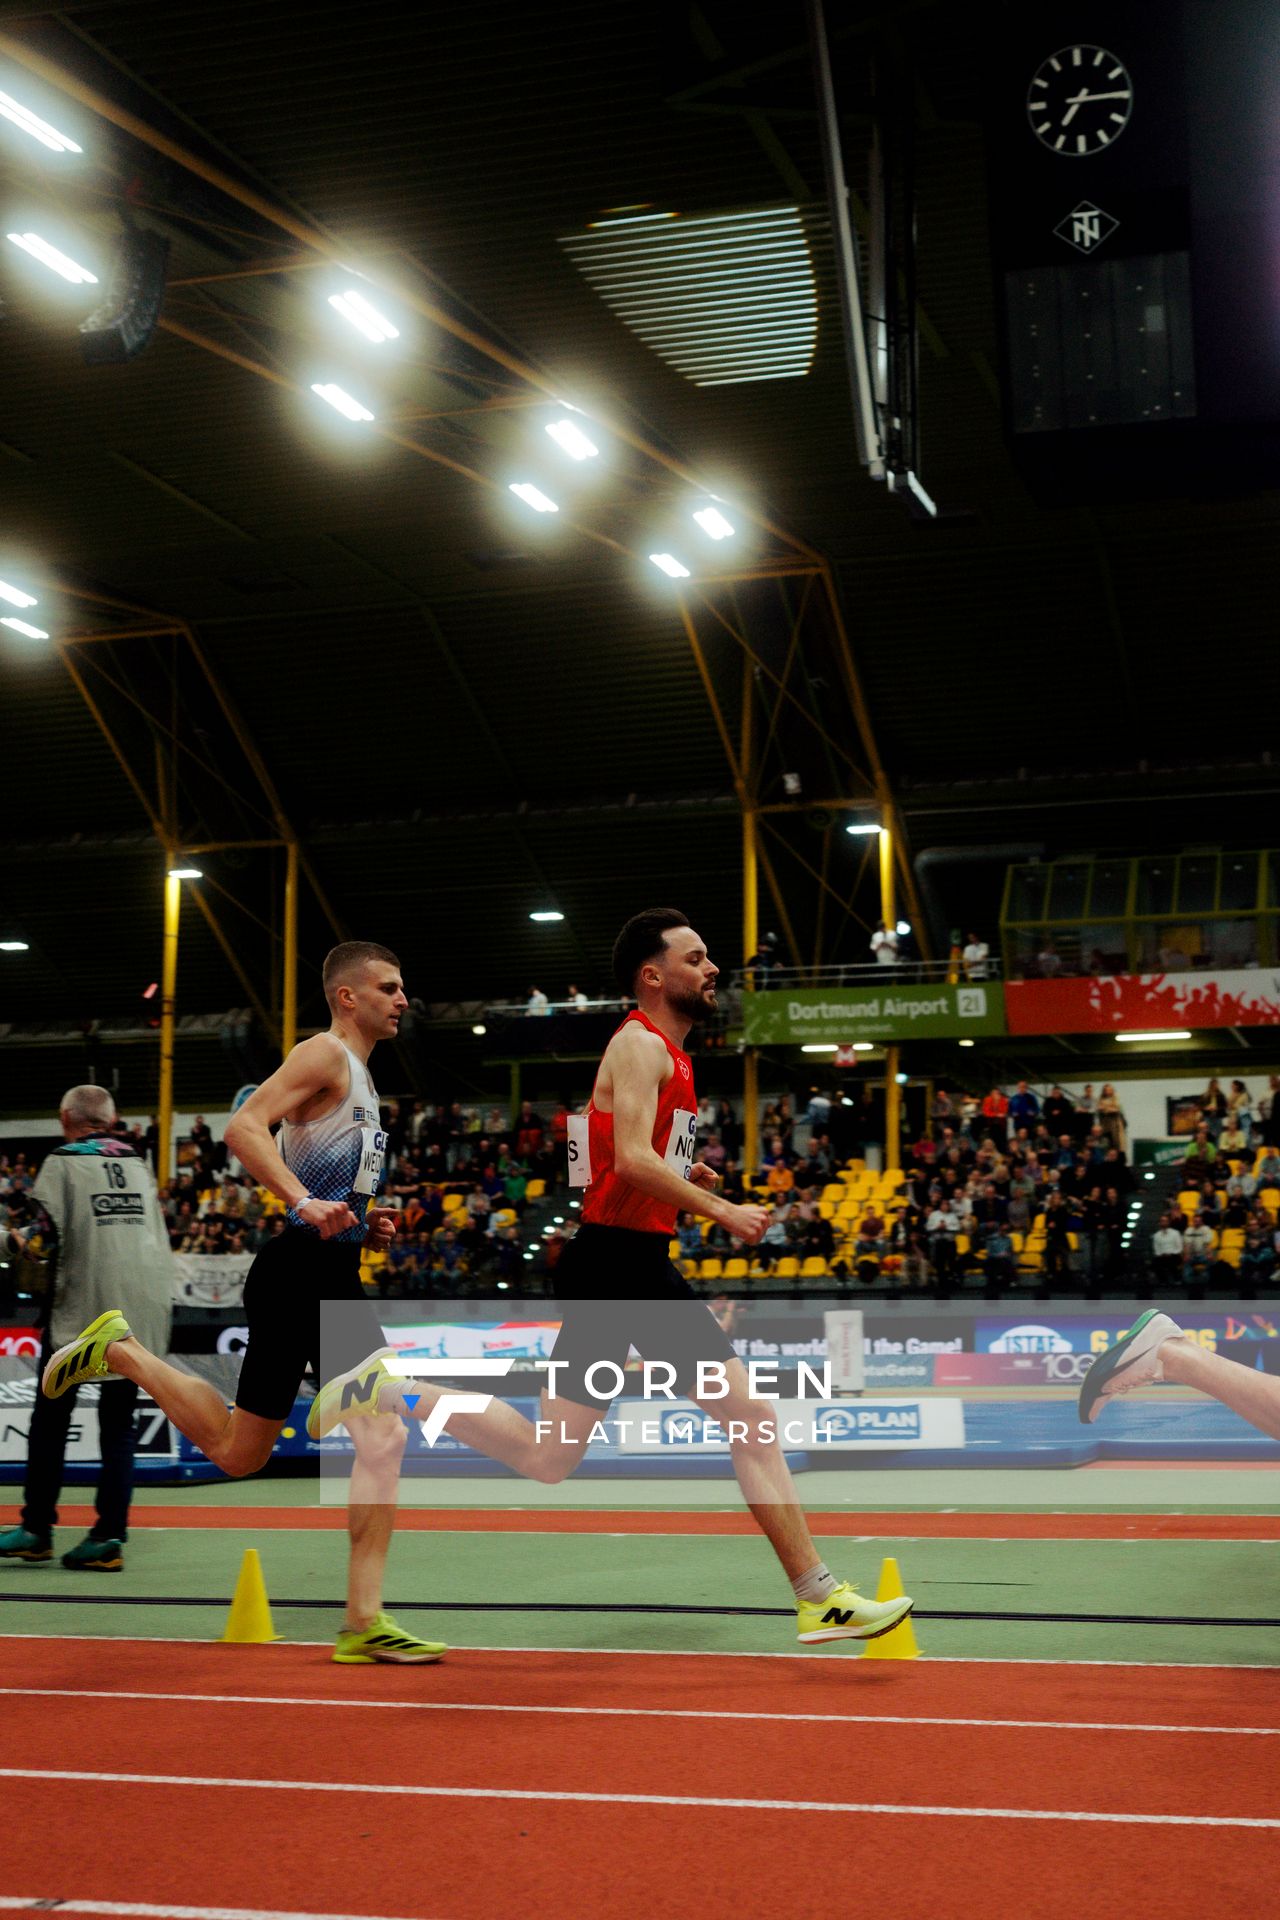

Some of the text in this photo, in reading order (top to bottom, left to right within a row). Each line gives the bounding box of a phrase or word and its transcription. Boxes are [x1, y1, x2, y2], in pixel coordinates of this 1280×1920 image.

[787, 999, 880, 1021] Dortmund
[883, 996, 949, 1020] Airport
[102, 1162, 127, 1189] 18
[857, 1411, 919, 1429] PLAN
